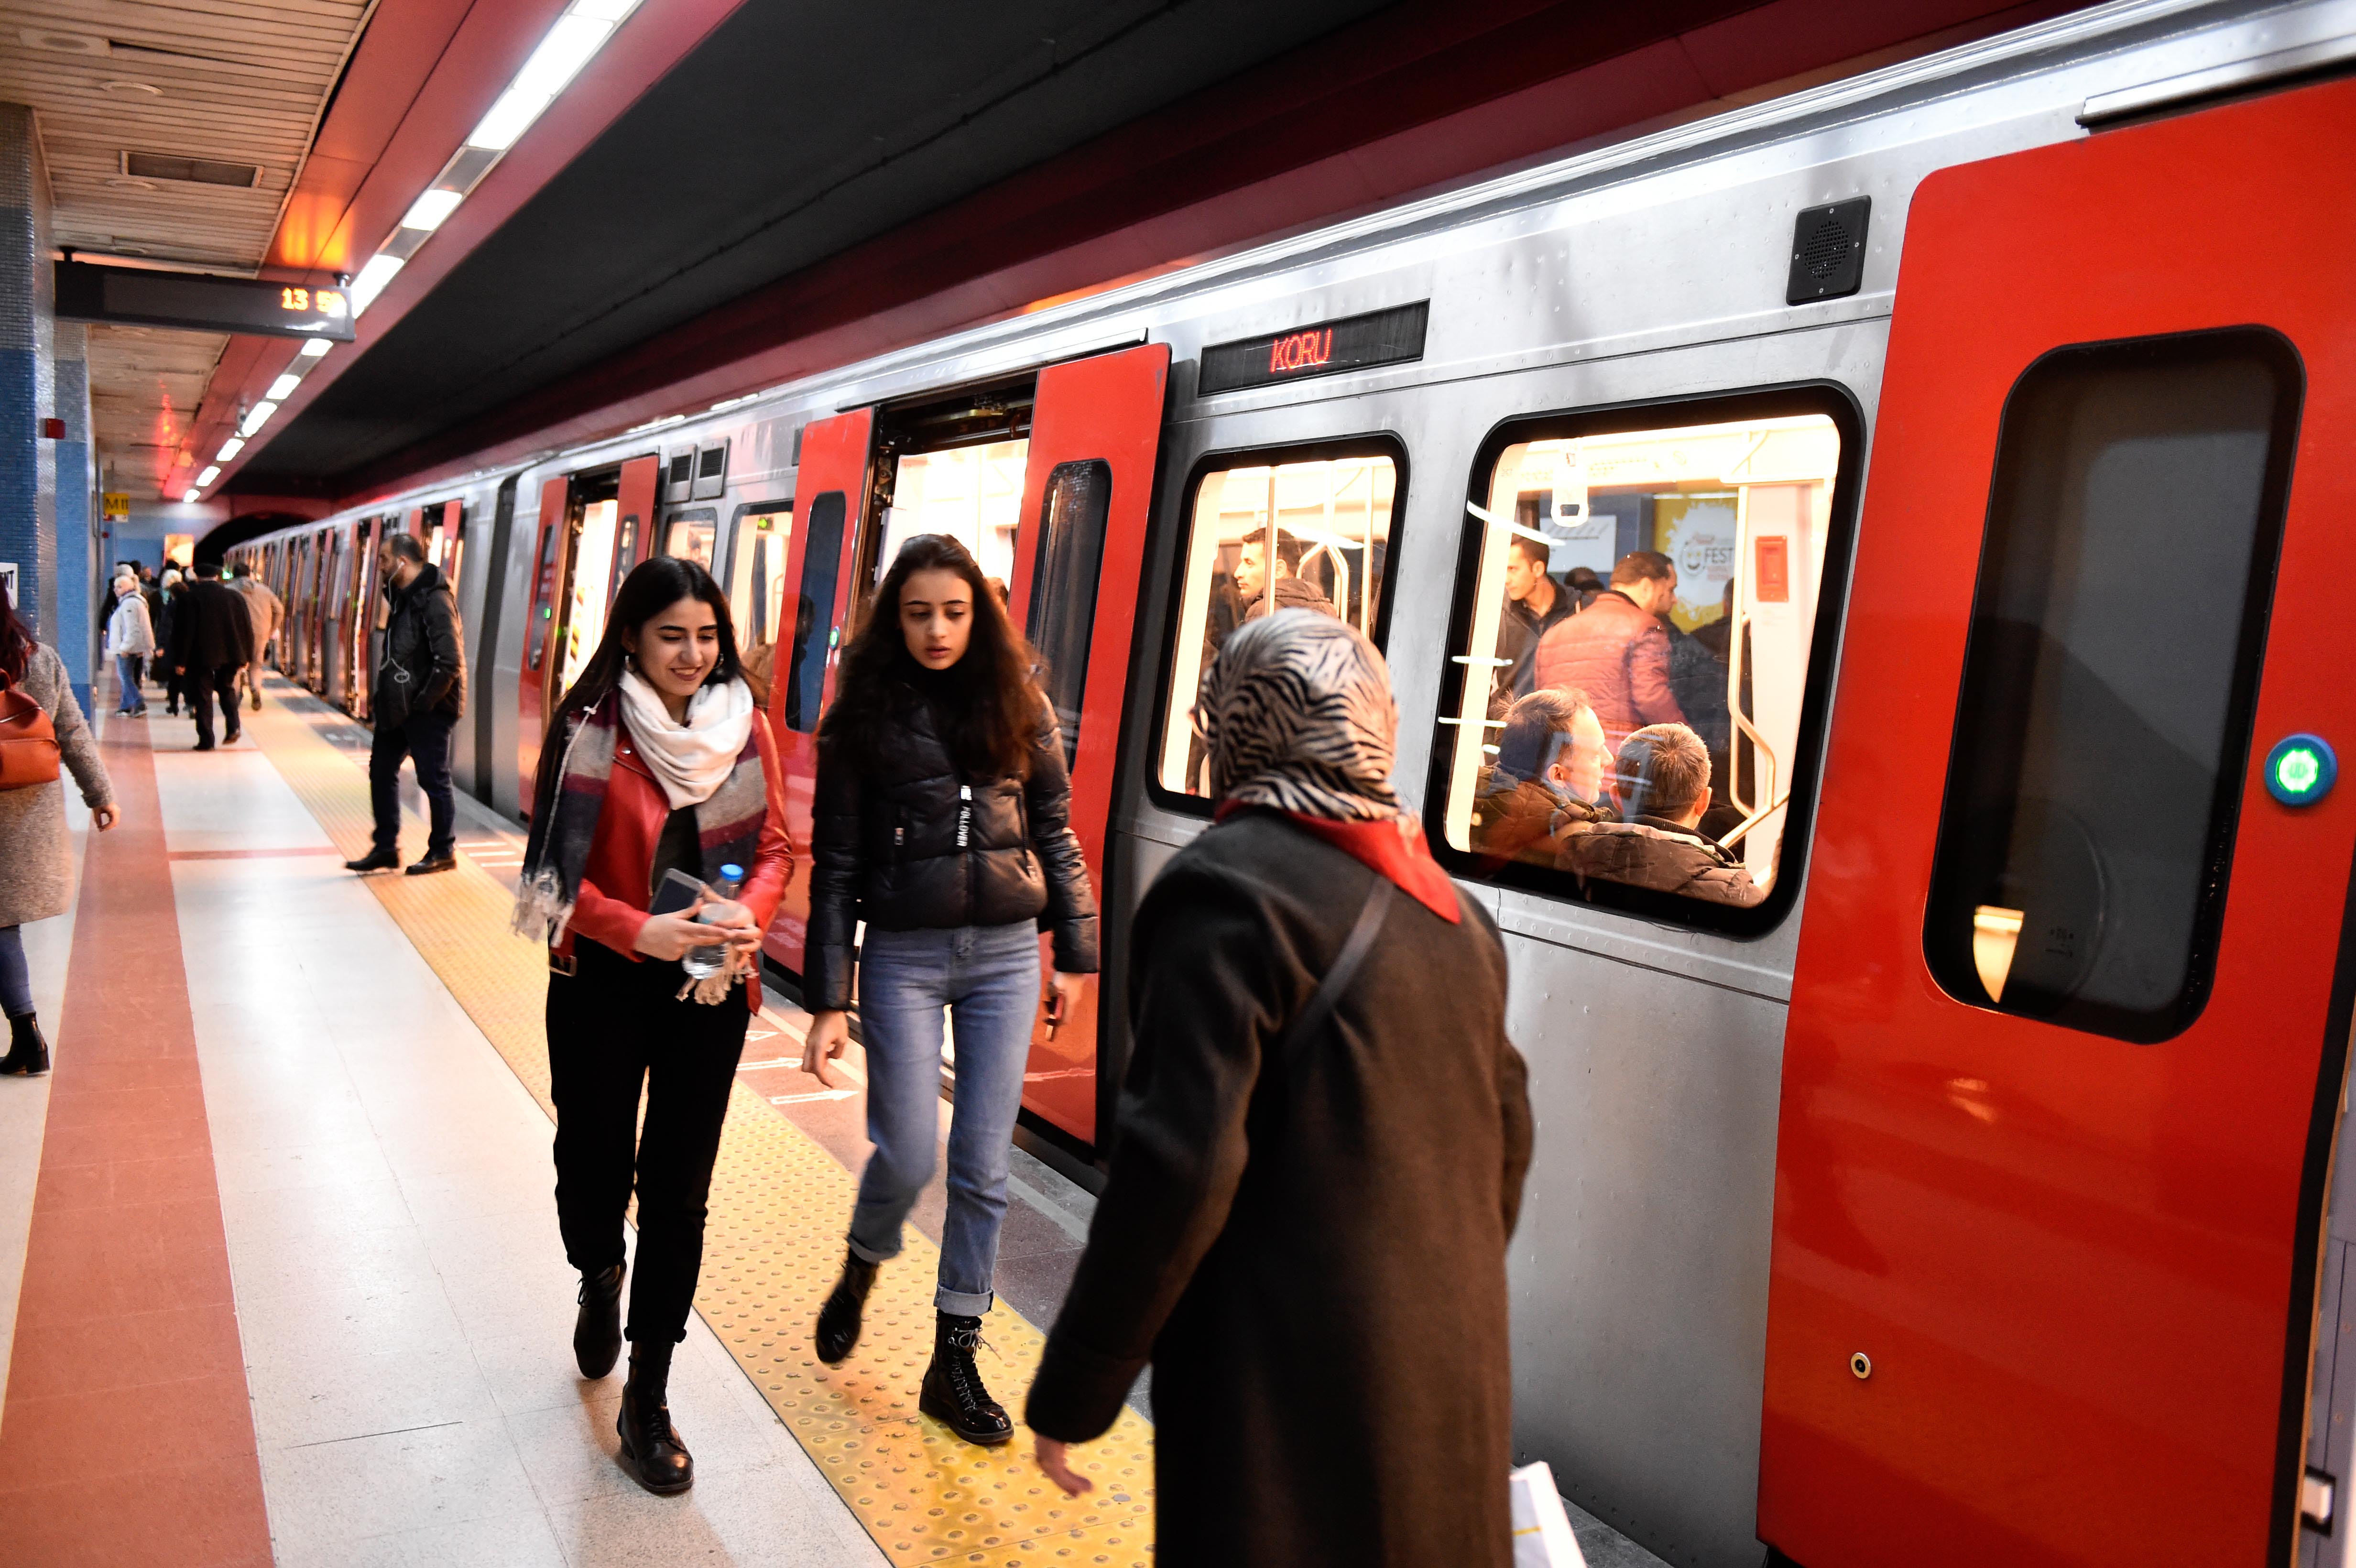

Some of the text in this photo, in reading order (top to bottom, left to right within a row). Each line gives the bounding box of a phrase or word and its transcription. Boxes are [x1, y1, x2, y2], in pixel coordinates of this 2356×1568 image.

[282, 287, 309, 311] 13
[1270, 328, 1331, 372] KORU
[1704, 546, 1734, 563] FEST
